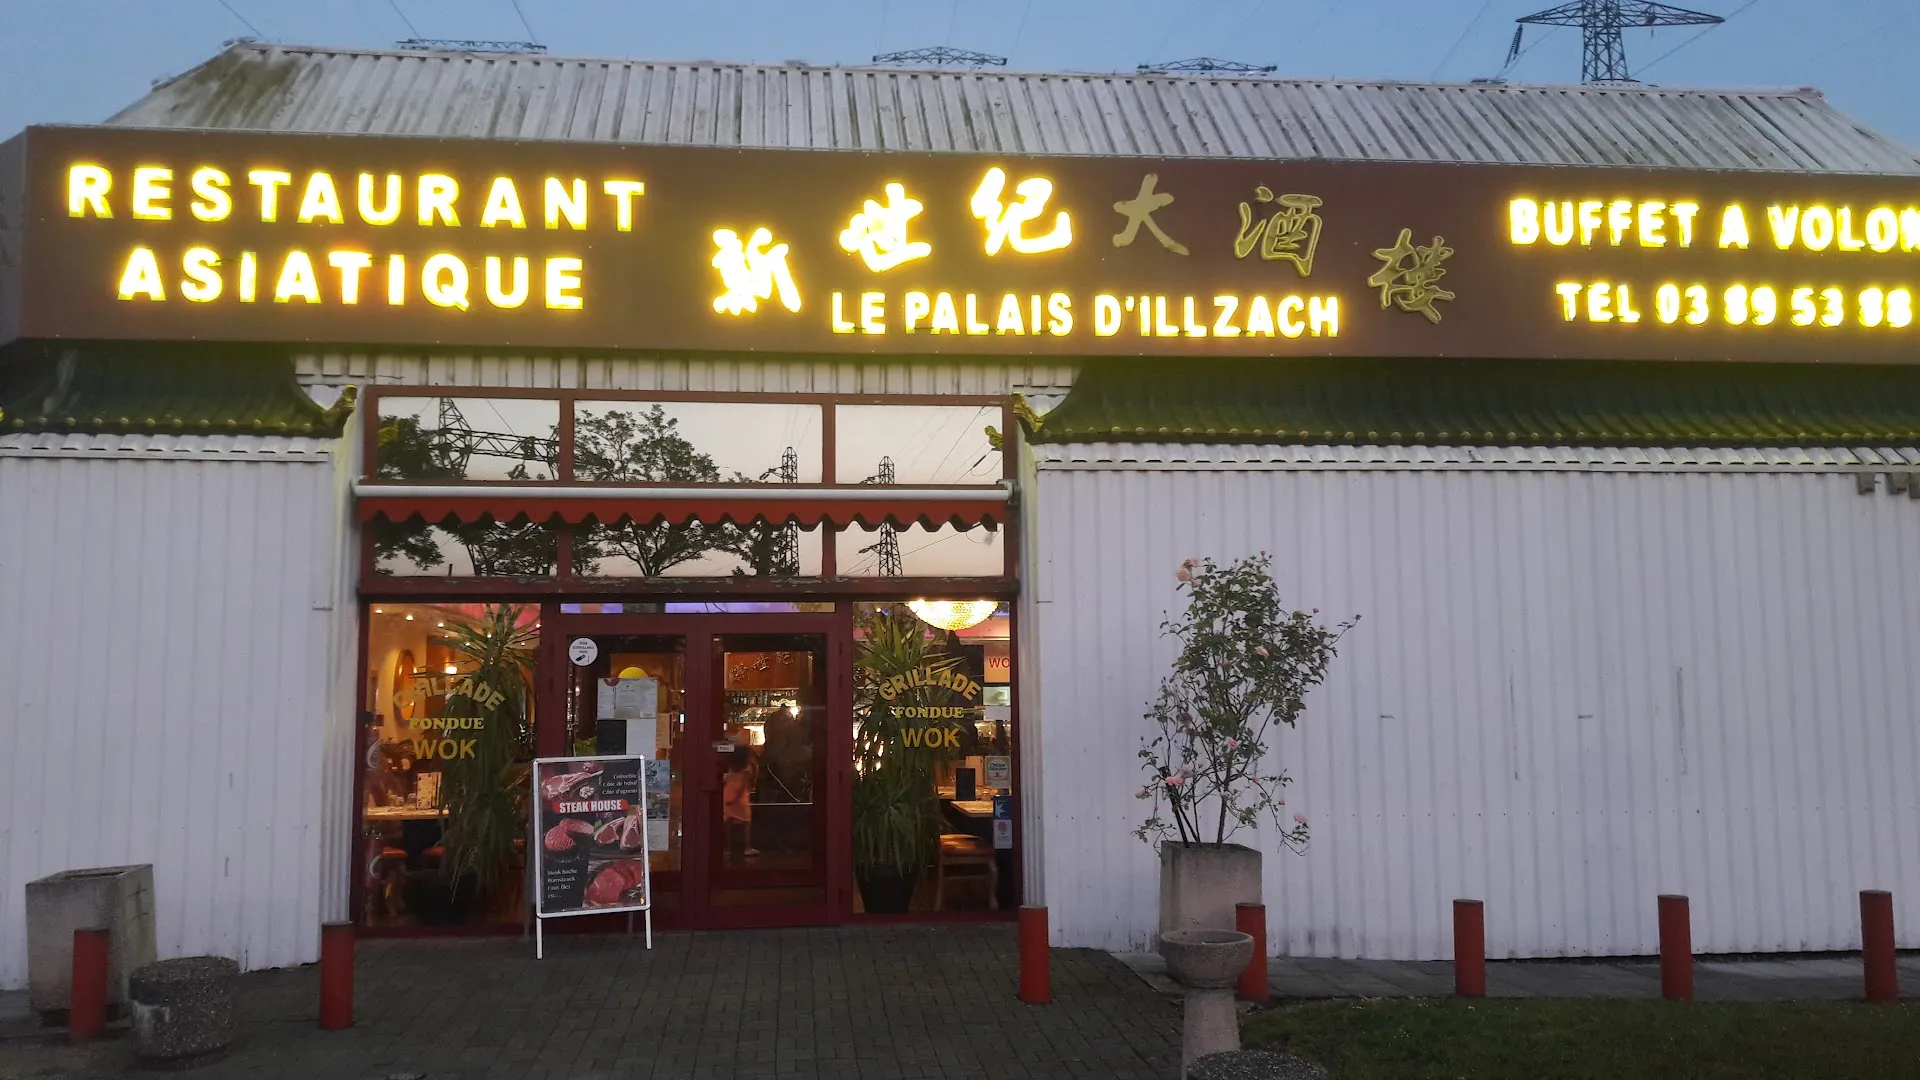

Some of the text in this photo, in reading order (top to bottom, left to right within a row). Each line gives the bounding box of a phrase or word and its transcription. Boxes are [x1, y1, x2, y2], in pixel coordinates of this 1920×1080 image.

[68, 163, 645, 233] RESTAURANT
[1509, 198, 1700, 249] BUFFET
[1718, 203, 1749, 250] A
[117, 246, 584, 312] ASIATIQUE
[831, 291, 1340, 338] LE PALAIS D'ILLZACH
[1555, 281, 1641, 324] TEL
[1656, 283, 1710, 326] 03
[1723, 284, 1778, 327] 89
[1790, 286, 1845, 328] 53
[879, 667, 982, 702] GRILLADE
[409, 717, 485, 730] FONDUE
[893, 706, 965, 719] FONDUE
[411, 739, 478, 760] WOK
[900, 727, 960, 749] WOK
[560, 800, 622, 814] STEAK HOUSE
